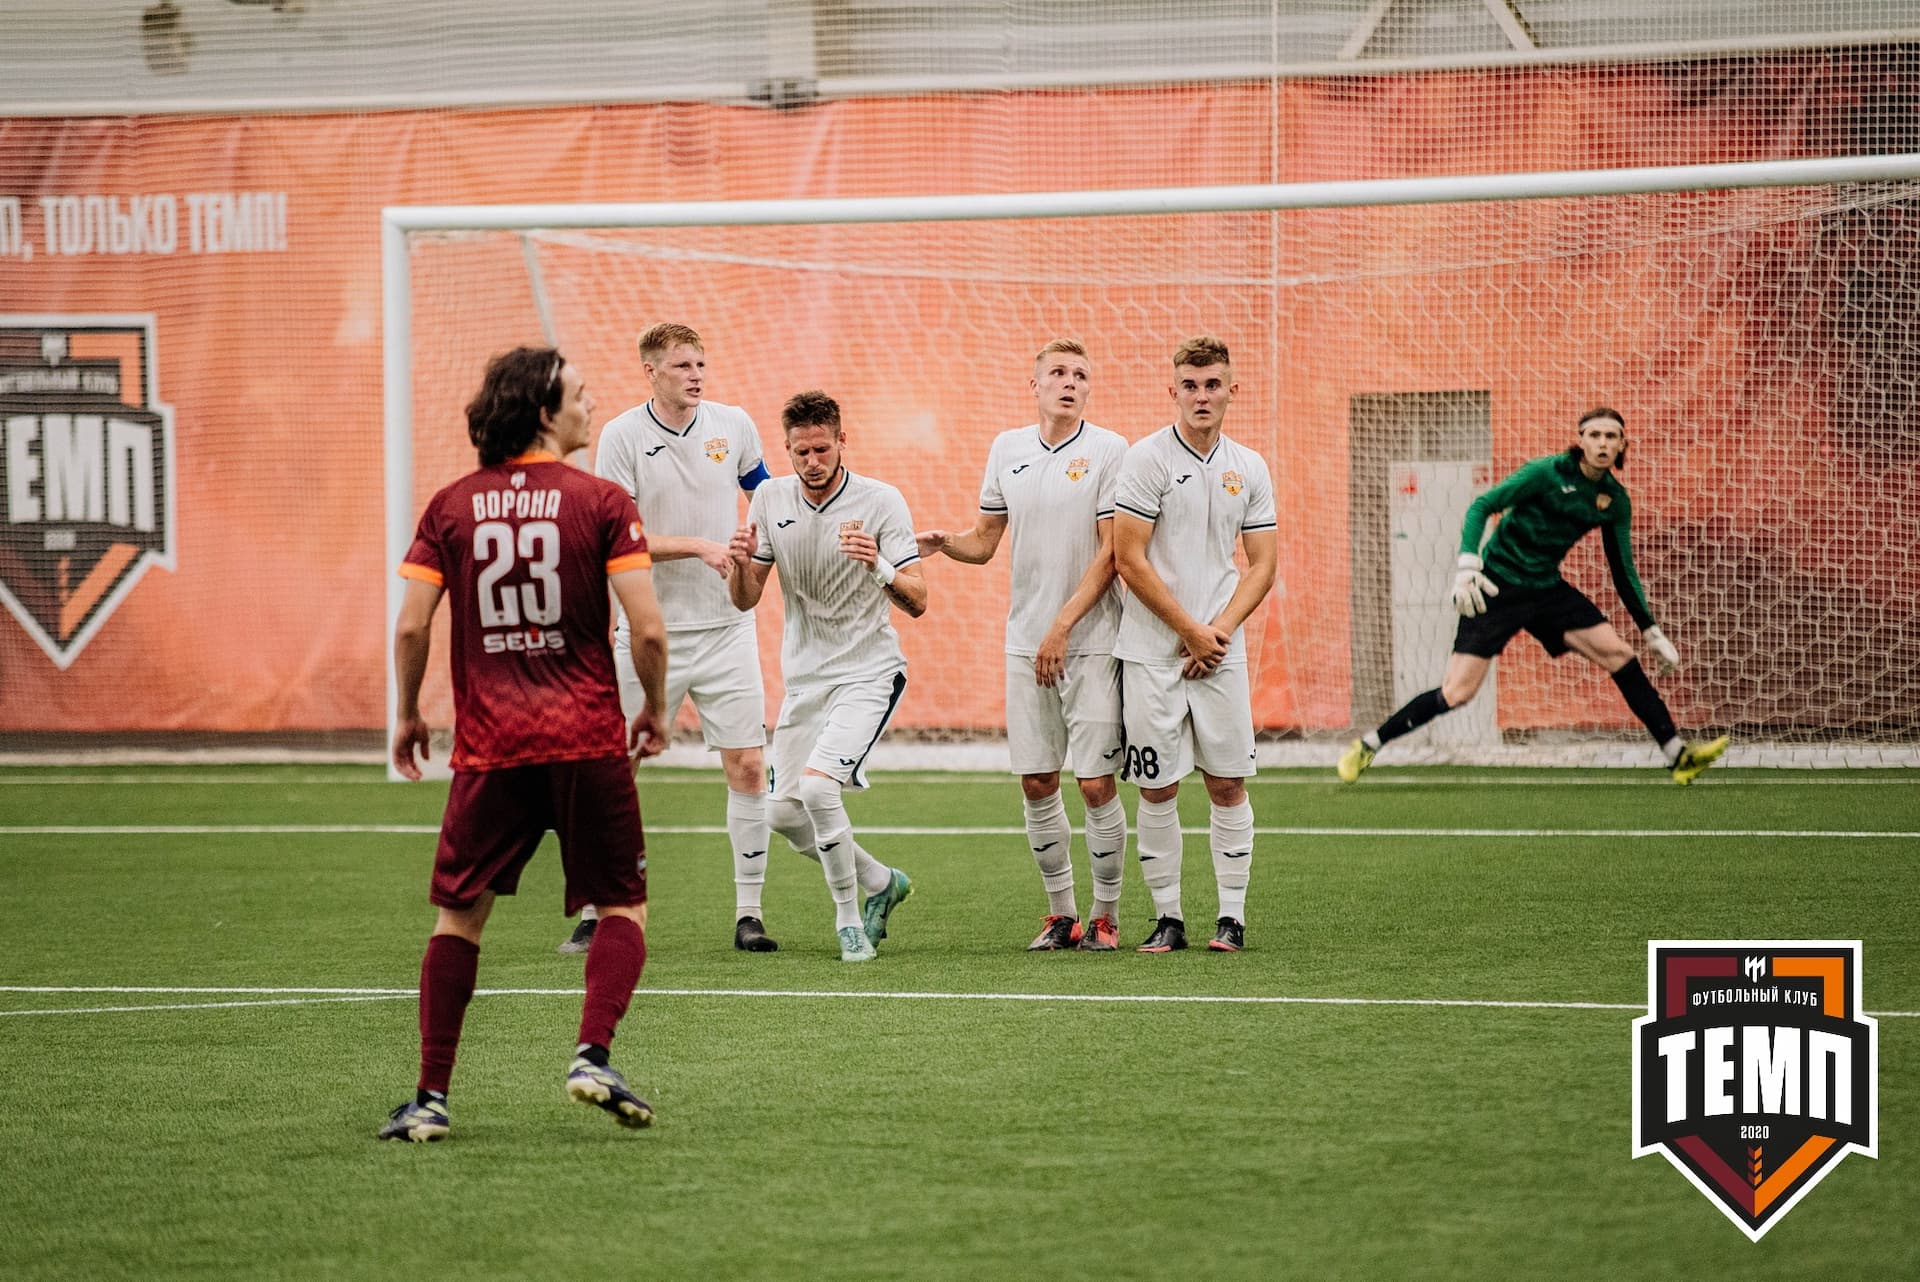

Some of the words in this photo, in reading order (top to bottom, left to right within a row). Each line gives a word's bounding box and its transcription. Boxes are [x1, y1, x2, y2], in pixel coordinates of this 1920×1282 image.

[40, 194, 177, 255] ТОЛЬКО
[185, 191, 288, 253] ТЕМП!
[0, 413, 155, 533] ЕМП
[472, 489, 562, 522] ВОРОНА
[473, 520, 562, 628] 23
[483, 630, 565, 653] SEUS
